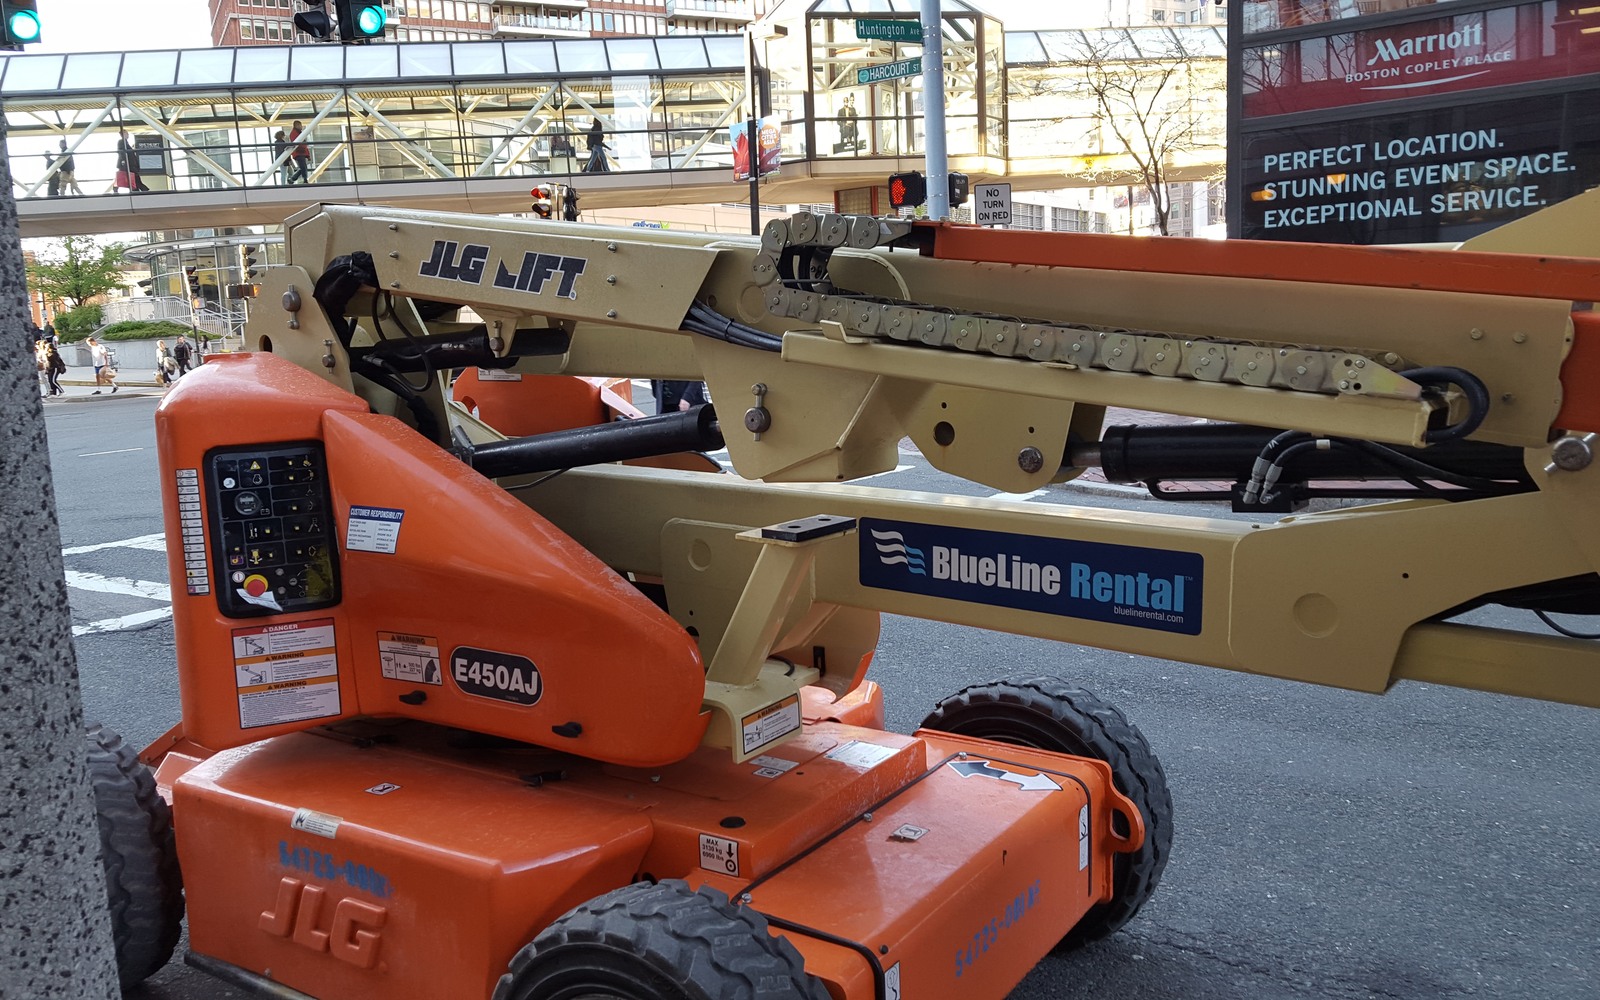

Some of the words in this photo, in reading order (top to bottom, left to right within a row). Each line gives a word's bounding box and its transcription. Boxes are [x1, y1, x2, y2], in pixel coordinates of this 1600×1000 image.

[858, 21, 905, 37] Huntington
[1366, 22, 1482, 66] Marriott
[870, 62, 910, 80] HARCOURT
[912, 63, 920, 72] ST
[1345, 66, 1400, 83] BOSTON
[1405, 57, 1460, 75] COPLEY
[1465, 50, 1511, 66] PLACE
[1264, 143, 1366, 173] PERFECT
[1374, 128, 1504, 161] LOCATION.
[1263, 170, 1386, 201] STUNNING
[1395, 160, 1476, 188] EVENT
[1483, 151, 1576, 179] SPACE.
[986, 189, 1000, 197] NO
[983, 200, 1004, 209] TURN
[1263, 196, 1422, 229] EXCEPTIONAL
[1430, 185, 1547, 214] SERVICE.
[978, 212, 990, 220] ON
[992, 211, 1009, 220] RED
[418, 239, 491, 286] JLG
[350, 508, 370, 517] CUSTOMER
[370, 509, 403, 520] RESPONSIBILITY
[932, 545, 1061, 596] BlueLine
[1070, 562, 1185, 612] Rental
[1113, 605, 1185, 624] bluelinerental.com
[268, 623, 299, 633] DANGER
[396, 634, 426, 645] WARNING
[271, 652, 305, 661] WARNING
[273, 680, 307, 690] WARNING
[455, 657, 538, 696] E450AJ
[702, 844, 714, 852] 3130
[706, 838, 719, 846] MAX
[258, 876, 388, 969] JLG
